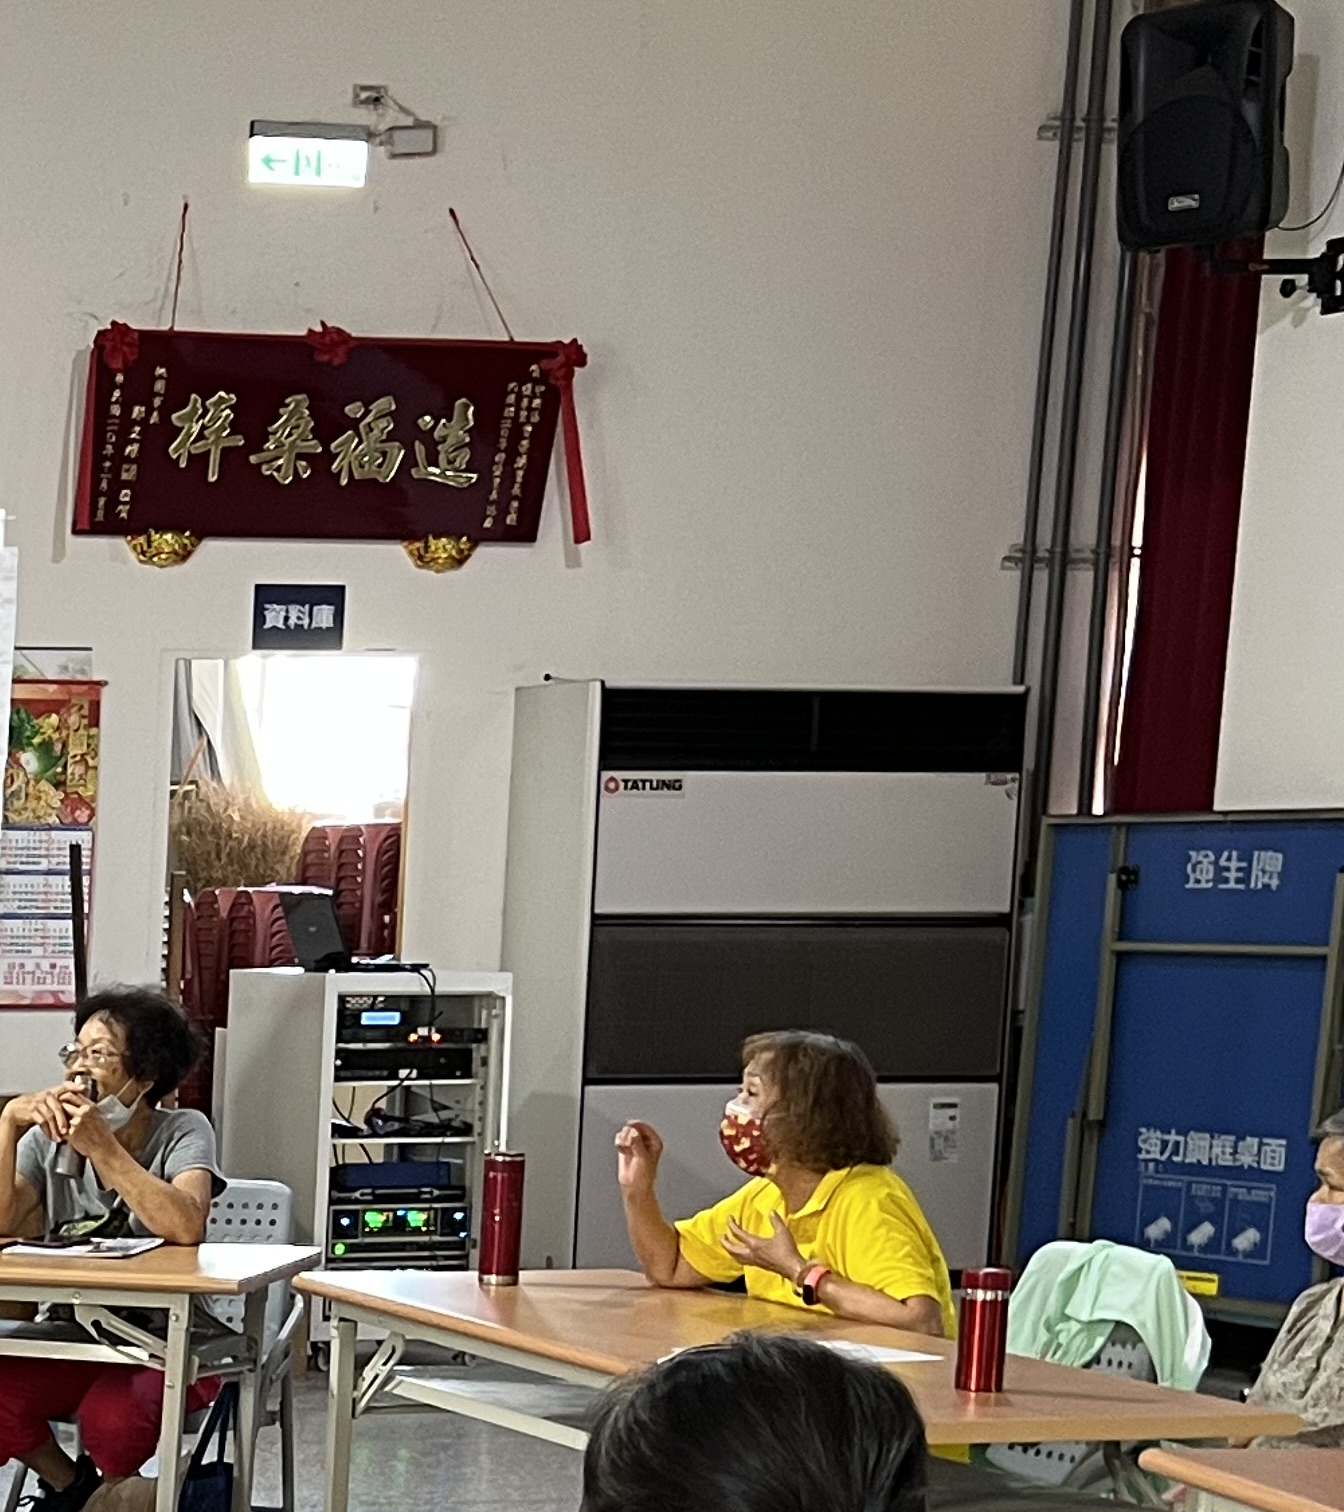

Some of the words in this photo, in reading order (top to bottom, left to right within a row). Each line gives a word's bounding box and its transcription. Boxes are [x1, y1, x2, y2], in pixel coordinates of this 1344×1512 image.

[263, 603, 335, 630] 資料庫
[620, 779, 683, 791] TATUNG
[1184, 850, 1283, 890] 強生牌
[1137, 1127, 1287, 1172] 強力鋼框桌面
